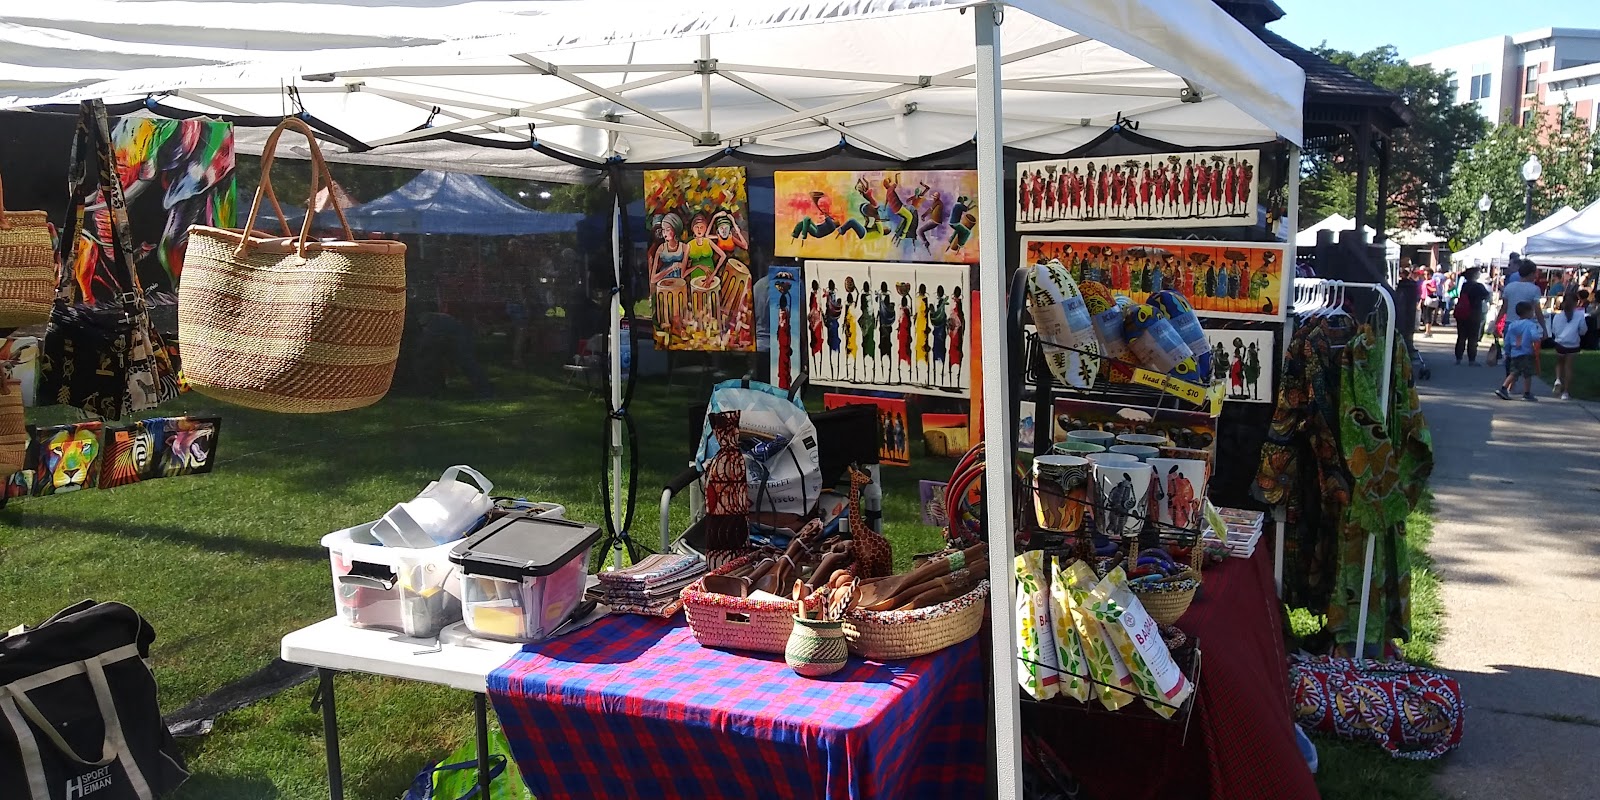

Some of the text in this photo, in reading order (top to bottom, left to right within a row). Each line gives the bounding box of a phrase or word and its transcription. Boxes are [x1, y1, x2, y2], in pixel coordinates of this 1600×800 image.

[1142, 374, 1159, 384] Head
[1160, 379, 1180, 392] Bnds
[1186, 389, 1199, 398] $10
[766, 478, 791, 489] TREET
[81, 766, 110, 783] SPORT
